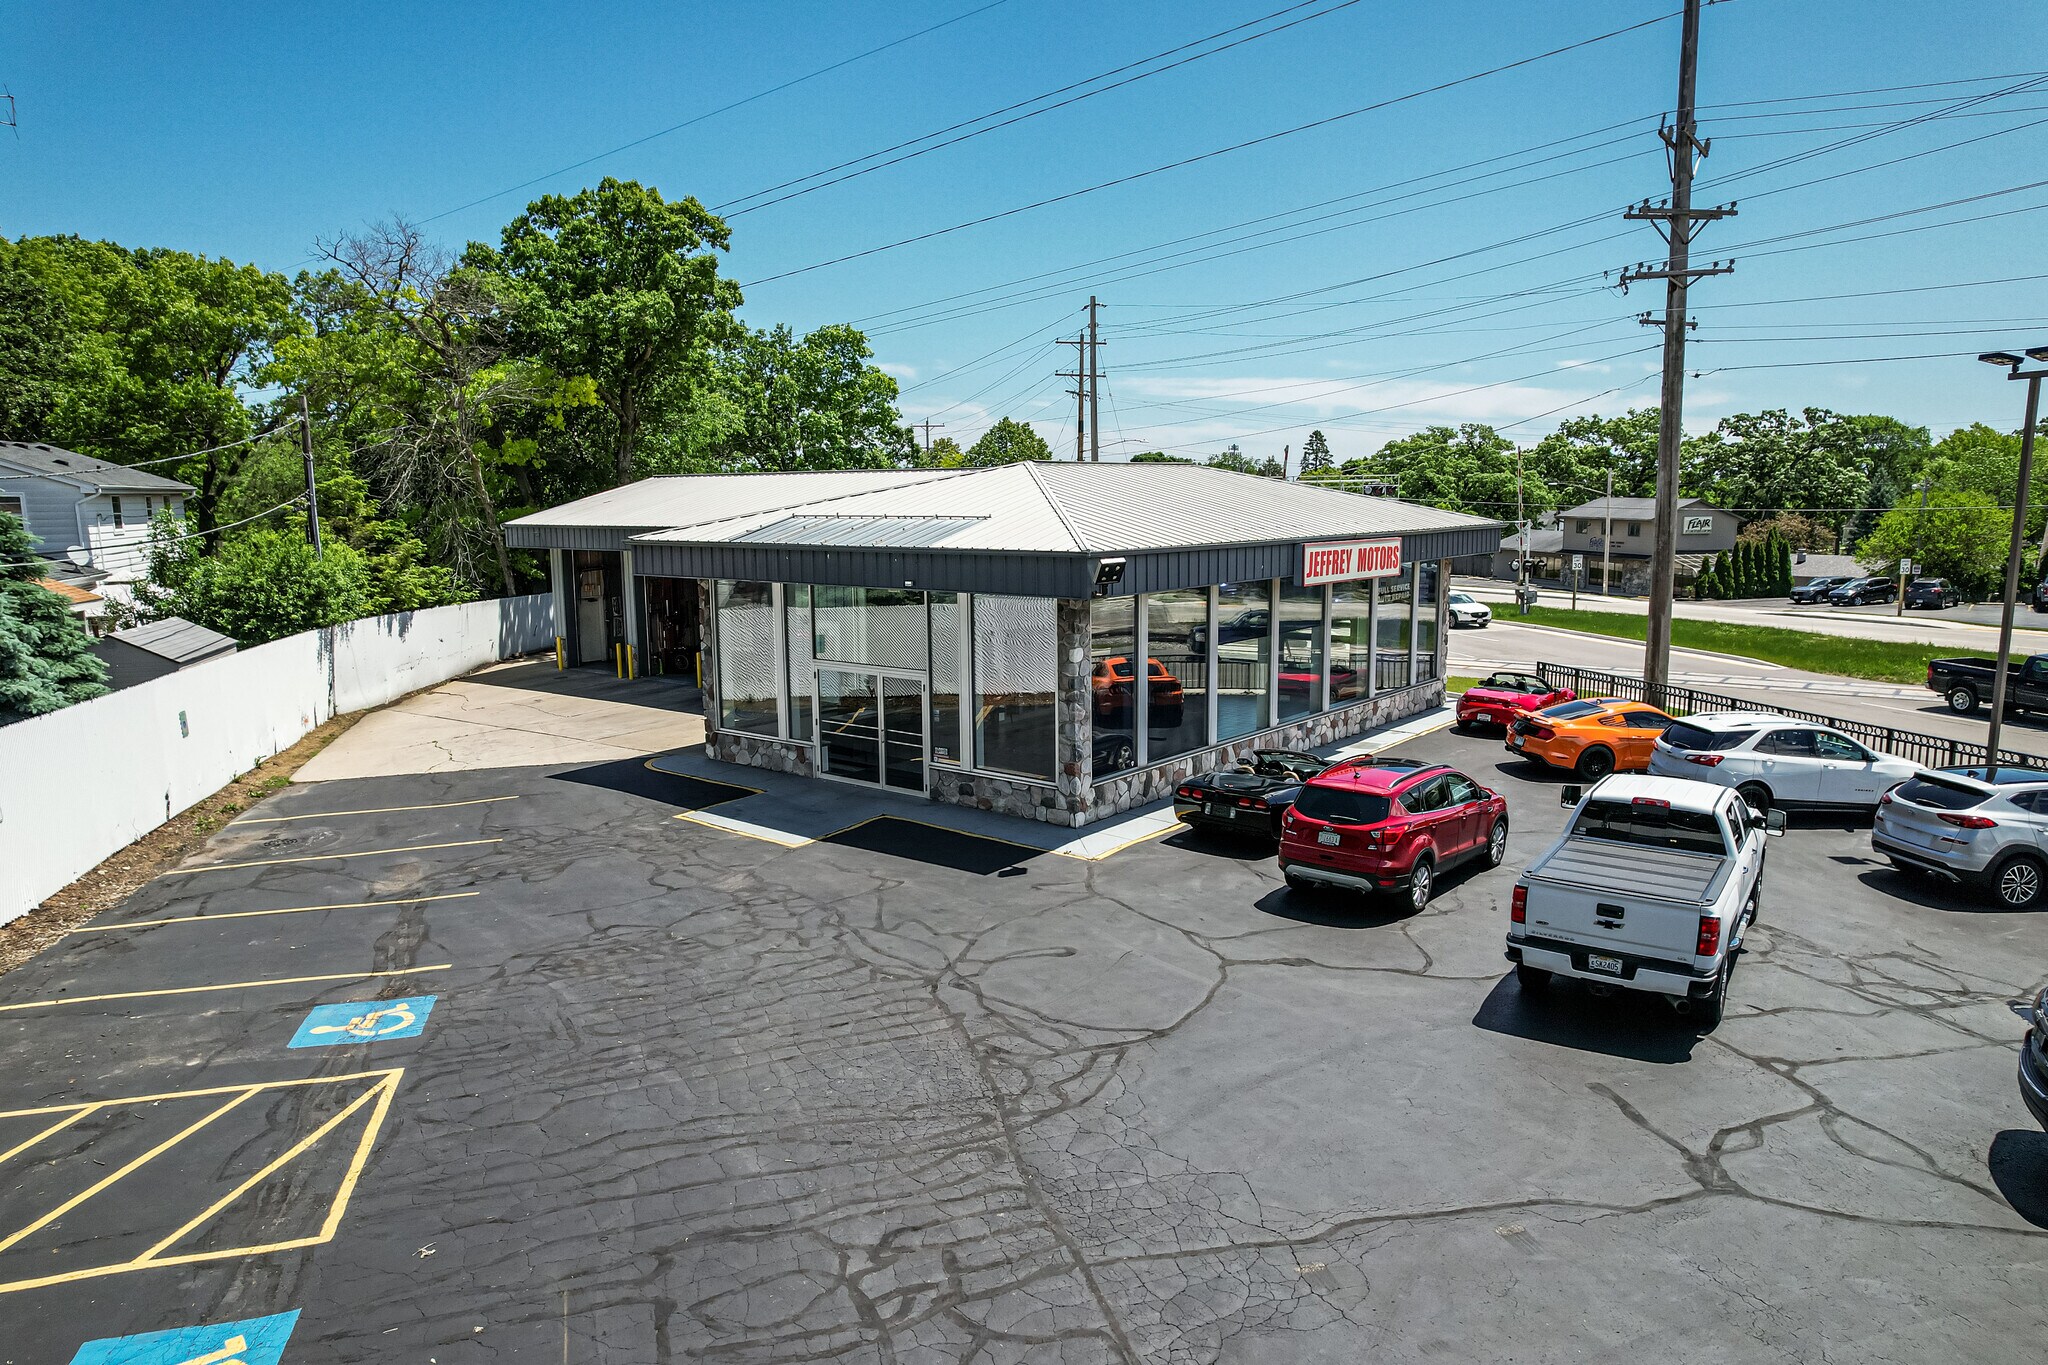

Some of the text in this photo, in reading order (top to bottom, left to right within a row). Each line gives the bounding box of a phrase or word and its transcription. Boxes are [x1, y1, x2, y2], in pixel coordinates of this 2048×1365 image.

[1687, 517, 1711, 530] FLAIR
[1306, 545, 1399, 578] JEFFREY MOTORS
[1390, 583, 1411, 592] SERVICE
